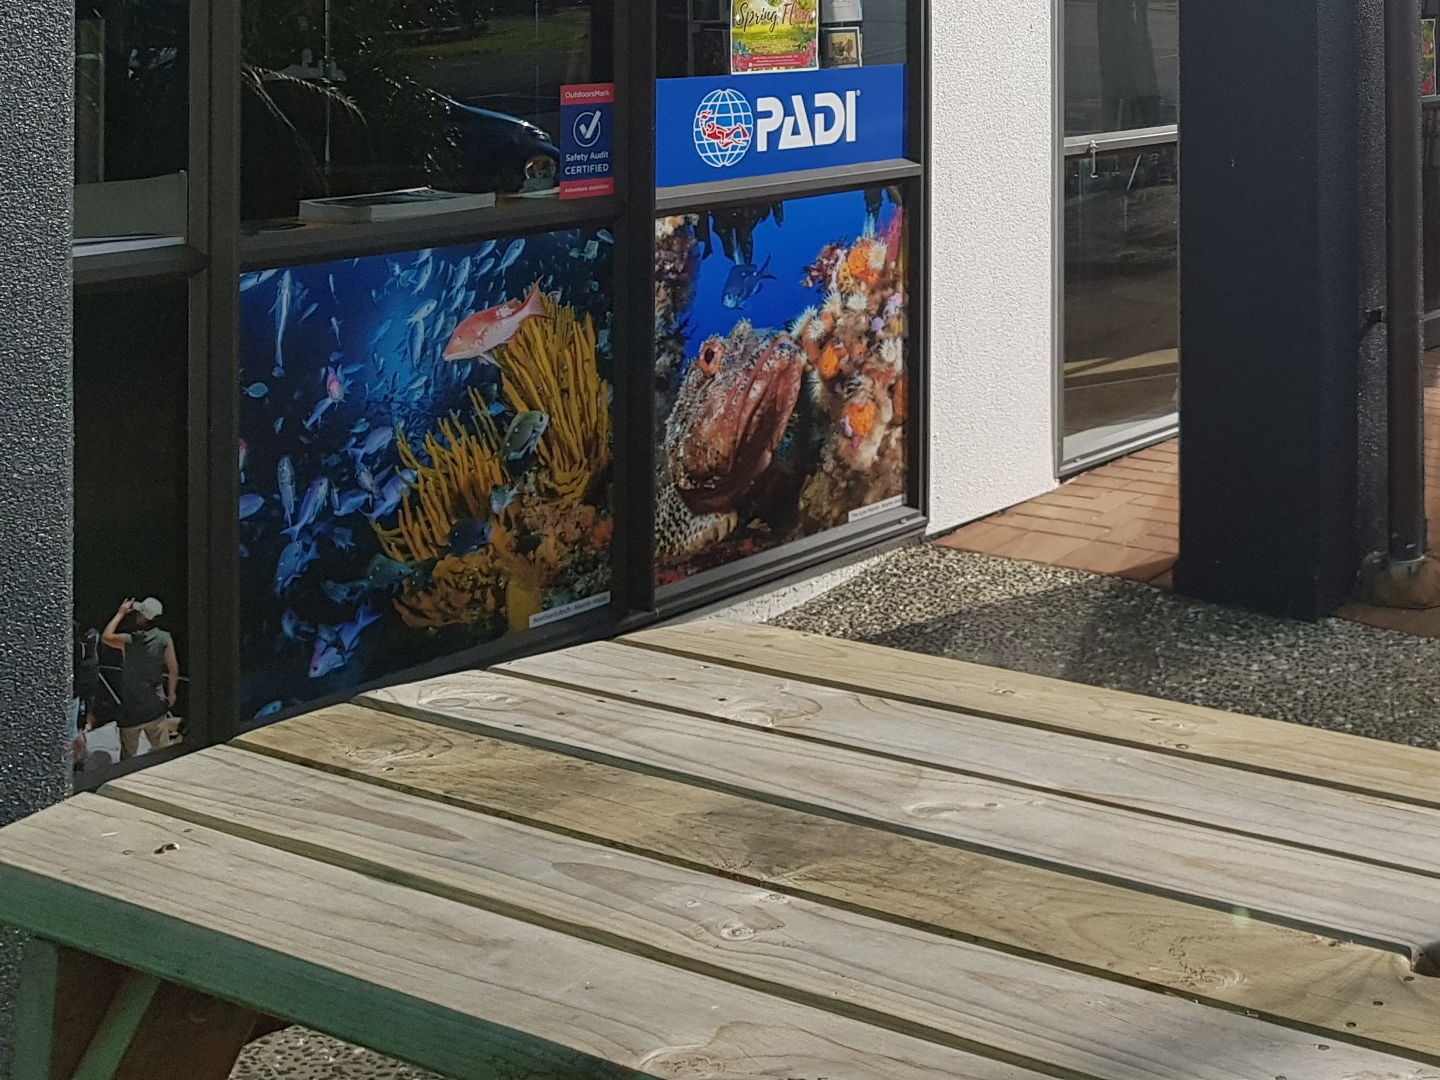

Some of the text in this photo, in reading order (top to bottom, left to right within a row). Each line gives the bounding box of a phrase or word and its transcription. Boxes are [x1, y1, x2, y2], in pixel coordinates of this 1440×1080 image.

[736, 0, 813, 33] Spring Fling
[756, 89, 856, 152] PADI
[565, 151, 609, 162] Safety Audit
[565, 163, 609, 175] CERTIFIED
